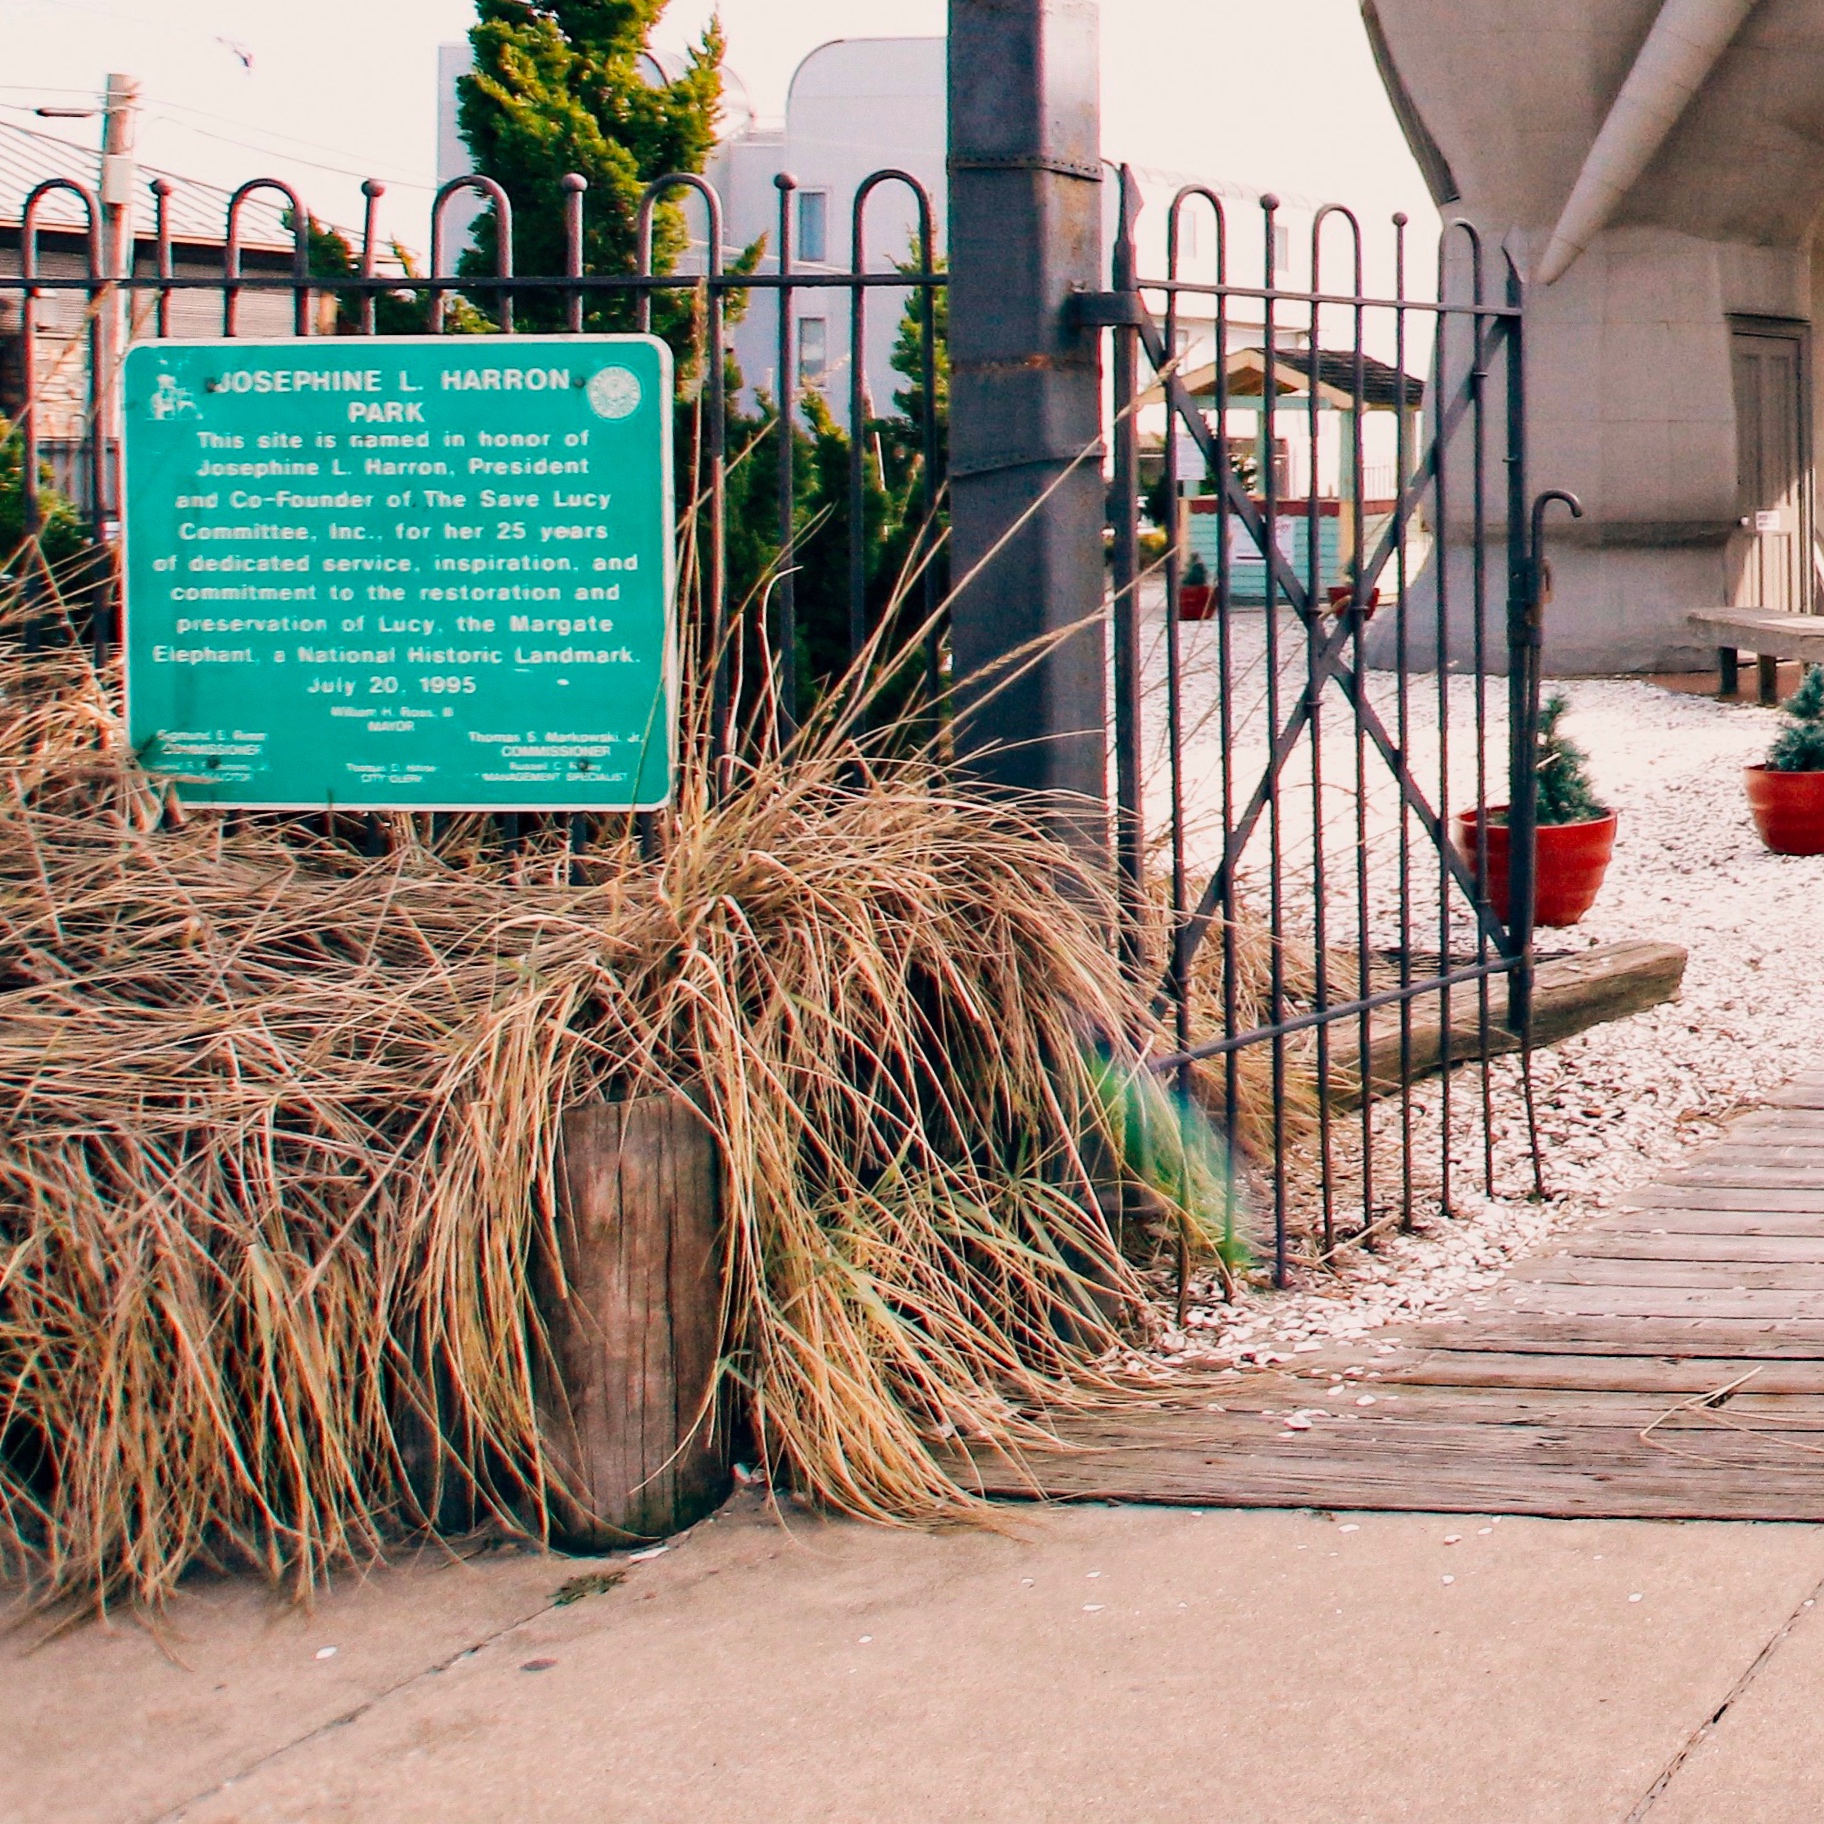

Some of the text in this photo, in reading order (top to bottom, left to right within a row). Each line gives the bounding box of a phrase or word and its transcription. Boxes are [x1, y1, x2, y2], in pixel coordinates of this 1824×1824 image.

[213, 369, 383, 394] JOSEPHINE
[399, 370, 424, 393] L.
[441, 367, 571, 392] HARRON
[347, 400, 426, 424] PARK
[196, 429, 590, 450] This site is named in honor of
[195, 458, 320, 479] Josephine
[330, 458, 352, 476] L.
[467, 457, 589, 476] President
[174, 488, 612, 511] and Co-Founder of The Save Lucy
[395, 522, 432, 541] for
[443, 522, 485, 541] her
[496, 521, 527, 541] 25
[539, 524, 609, 544] years
[151, 554, 178, 573] of
[187, 554, 310, 573] dedicated
[591, 553, 639, 572] and
[169, 583, 621, 602] commitment to the restoration and
[175, 615, 328, 635] preservation
[340, 614, 366, 633] of
[455, 615, 497, 633] the
[508, 614, 615, 637] Margate
[273, 650, 287, 664] a
[296, 645, 396, 664] National
[406, 646, 504, 665] Historic
[513, 646, 641, 665] Landmark.
[306, 676, 356, 697] July
[418, 675, 478, 694] 1995
[500, 744, 611, 758] COMMISSIONER
